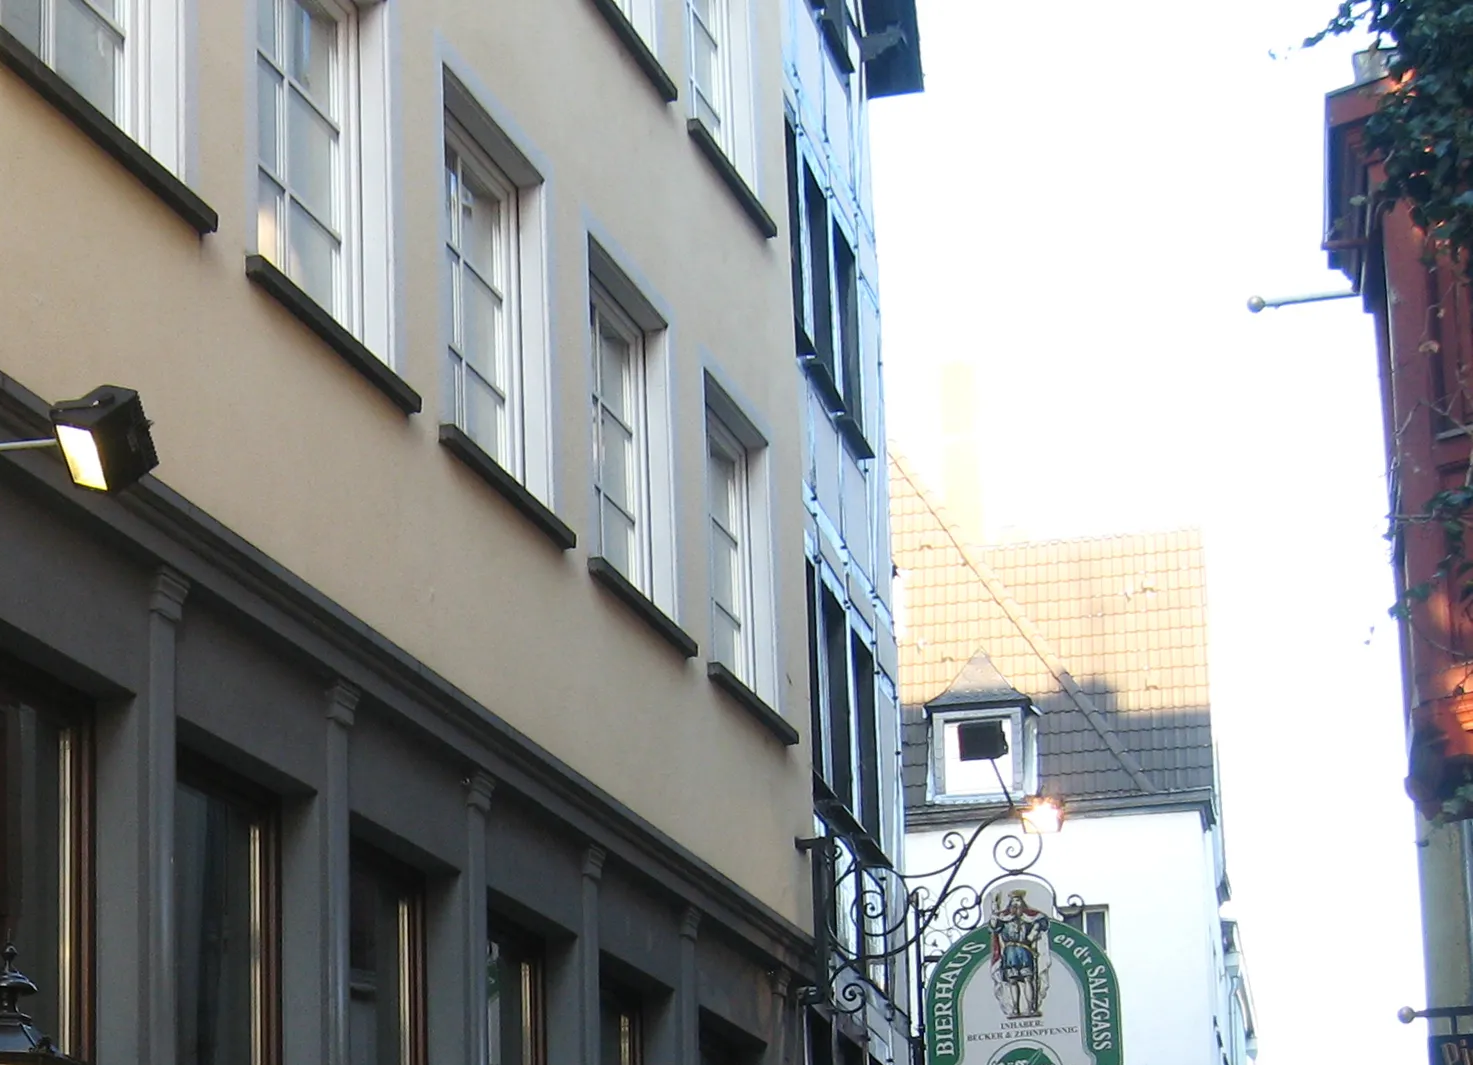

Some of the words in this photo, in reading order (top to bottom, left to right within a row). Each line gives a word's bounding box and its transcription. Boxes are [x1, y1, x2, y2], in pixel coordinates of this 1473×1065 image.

[933, 941, 988, 1057] BIERHAUS
[1052, 933, 1076, 949] en
[1087, 965, 1112, 1051] SALZGASS
[966, 1031, 1003, 1042] BECKER
[1005, 1030, 1013, 1039] &
[1014, 1025, 1079, 1038] ZEHNPFENNIG
